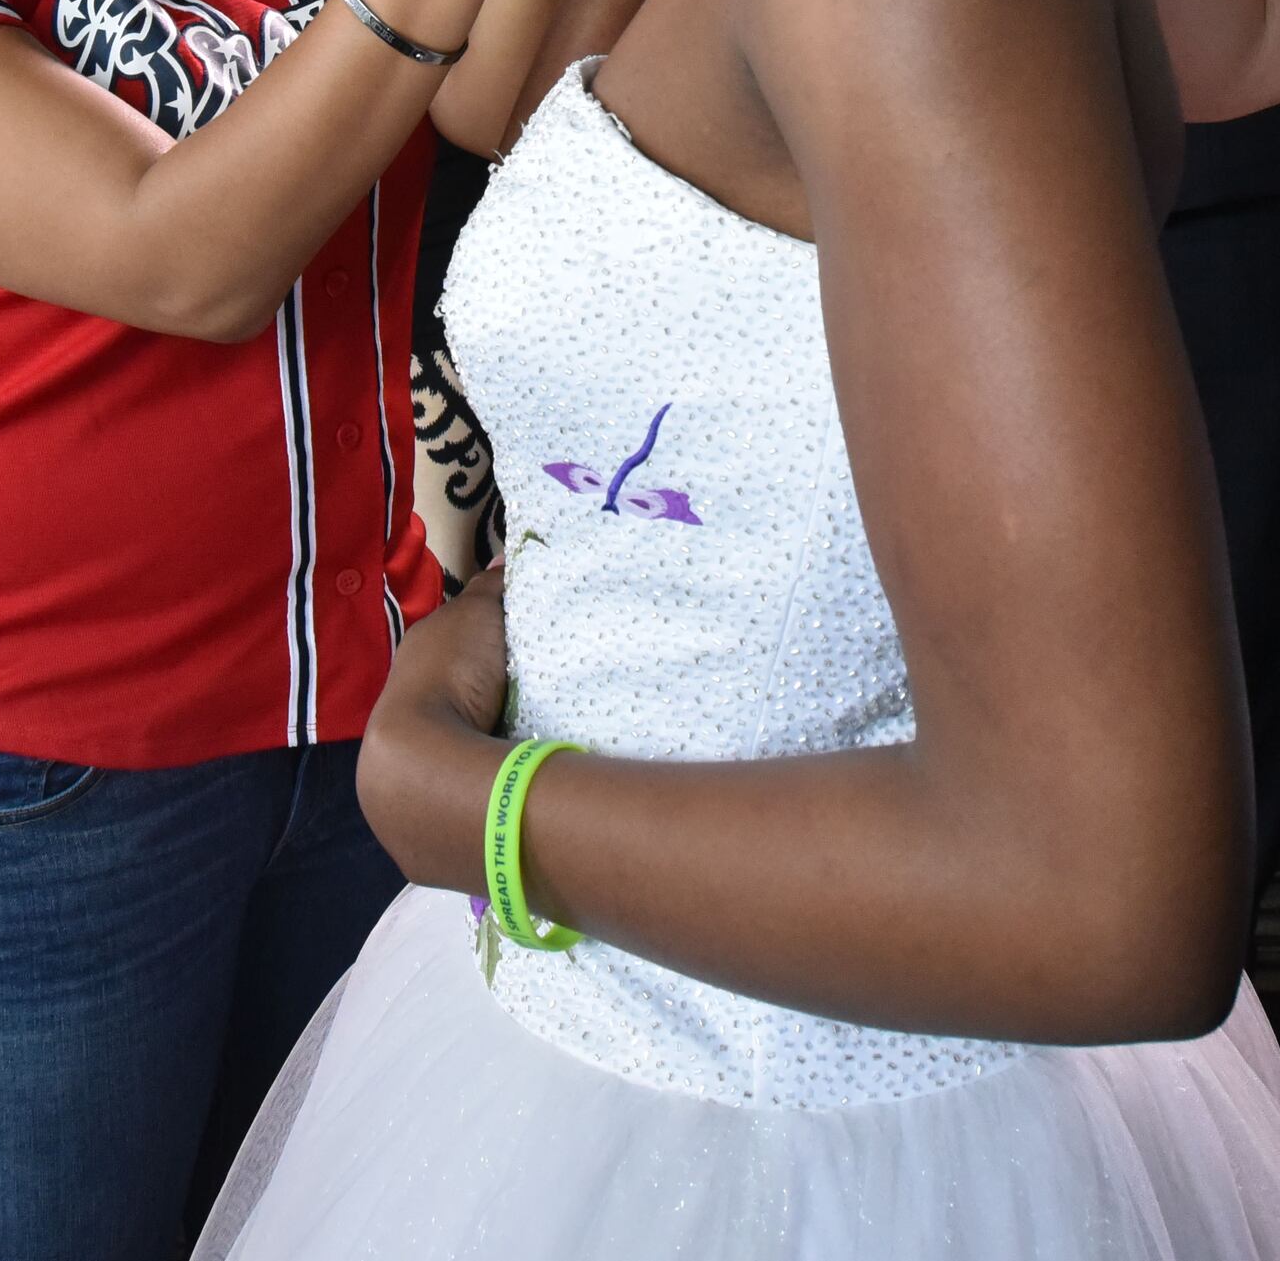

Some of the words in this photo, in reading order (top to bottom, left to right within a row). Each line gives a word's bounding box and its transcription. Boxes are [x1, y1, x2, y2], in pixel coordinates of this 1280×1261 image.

[512, 750, 531, 769] TO
[496, 771, 519, 828] WORD
[494, 831, 506, 867] THE
[495, 871, 520, 932] SPREAD
